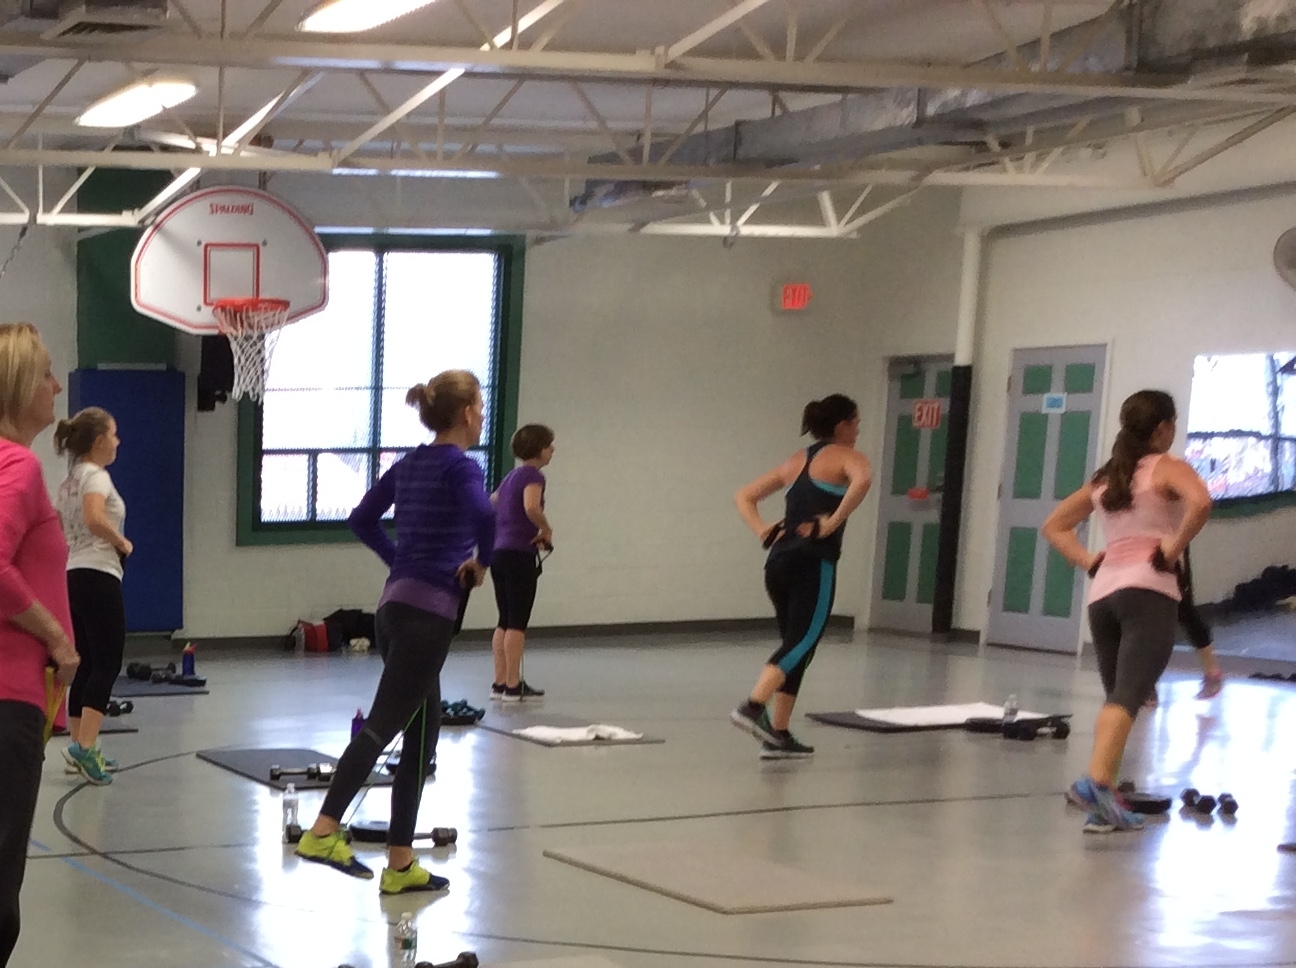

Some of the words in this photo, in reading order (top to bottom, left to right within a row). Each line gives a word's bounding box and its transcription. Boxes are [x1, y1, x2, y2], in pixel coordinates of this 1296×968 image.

[209, 203, 254, 215] SPALDING
[783, 284, 809, 308] EXIT
[914, 402, 940, 427] EXIT
